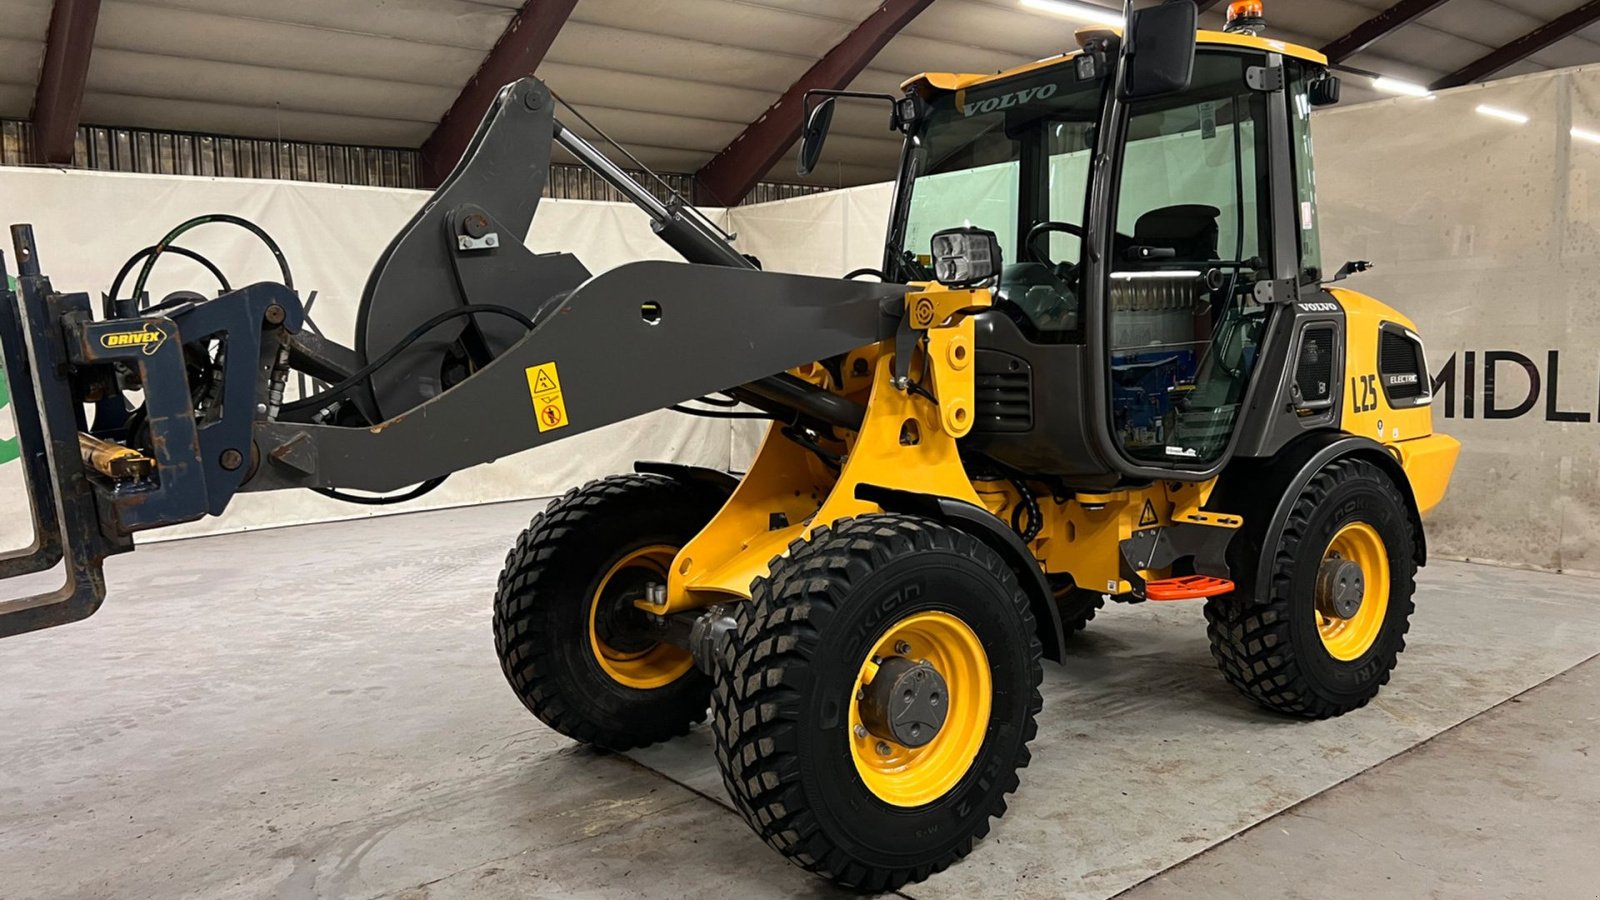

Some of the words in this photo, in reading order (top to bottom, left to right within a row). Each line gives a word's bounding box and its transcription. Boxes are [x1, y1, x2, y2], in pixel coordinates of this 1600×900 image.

[963, 83, 1057, 117] VOLVO
[1298, 303, 1338, 311] VOLVO
[107, 331, 160, 346] DRIVEX
[1390, 374, 1418, 384] ELECTRIC
[1351, 374, 1378, 413] L25
